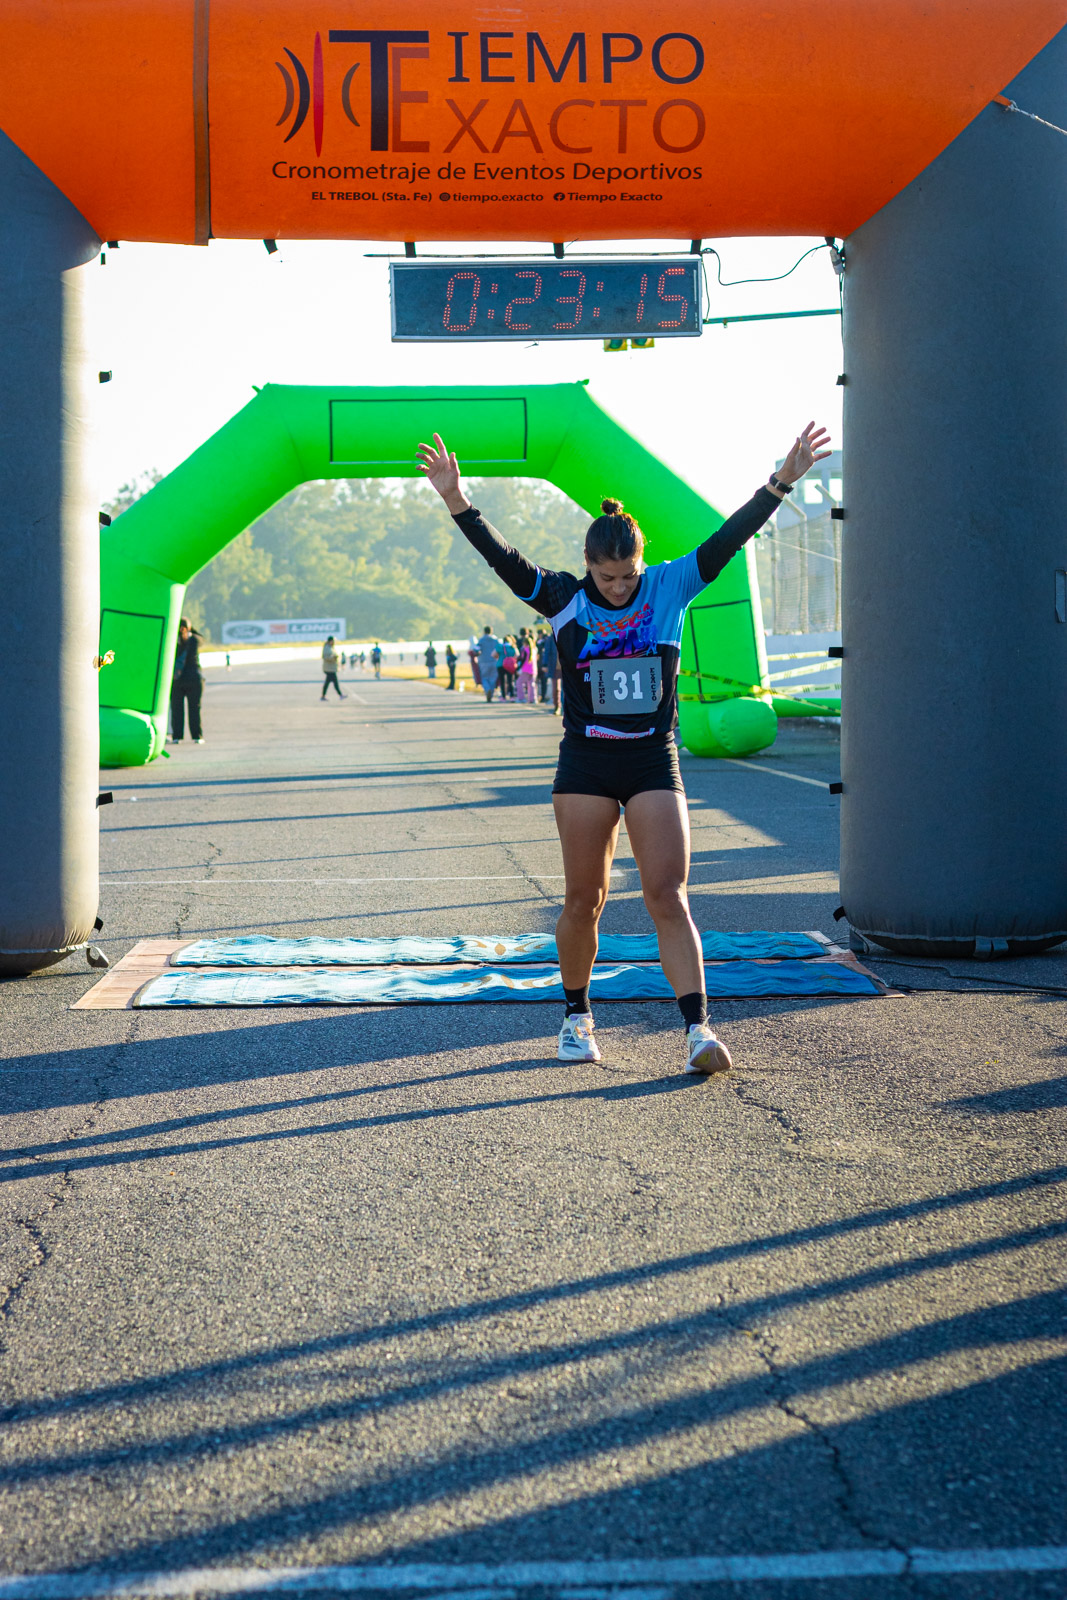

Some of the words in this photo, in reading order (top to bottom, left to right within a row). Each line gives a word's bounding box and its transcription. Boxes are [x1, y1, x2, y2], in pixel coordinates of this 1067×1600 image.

[272, 161, 430, 183] Cronometraje
[438, 162, 466, 180] de
[474, 163, 565, 180] Eventos
[573, 163, 702, 184] Deportivos
[312, 191, 326, 201] EL
[329, 191, 378, 201] TREBOL
[382, 192, 410, 203] (Sta.
[414, 192, 432, 203] Fe)
[453, 193, 544, 203] tiempo.exacto
[568, 192, 616, 203] Tiempo
[620, 192, 663, 201] Exacto
[443, 268, 688, 332] 0:23:15
[597, 669, 606, 704] TIEMPO
[613, 670, 644, 701] 31
[649, 667, 657, 701] EXACTO
